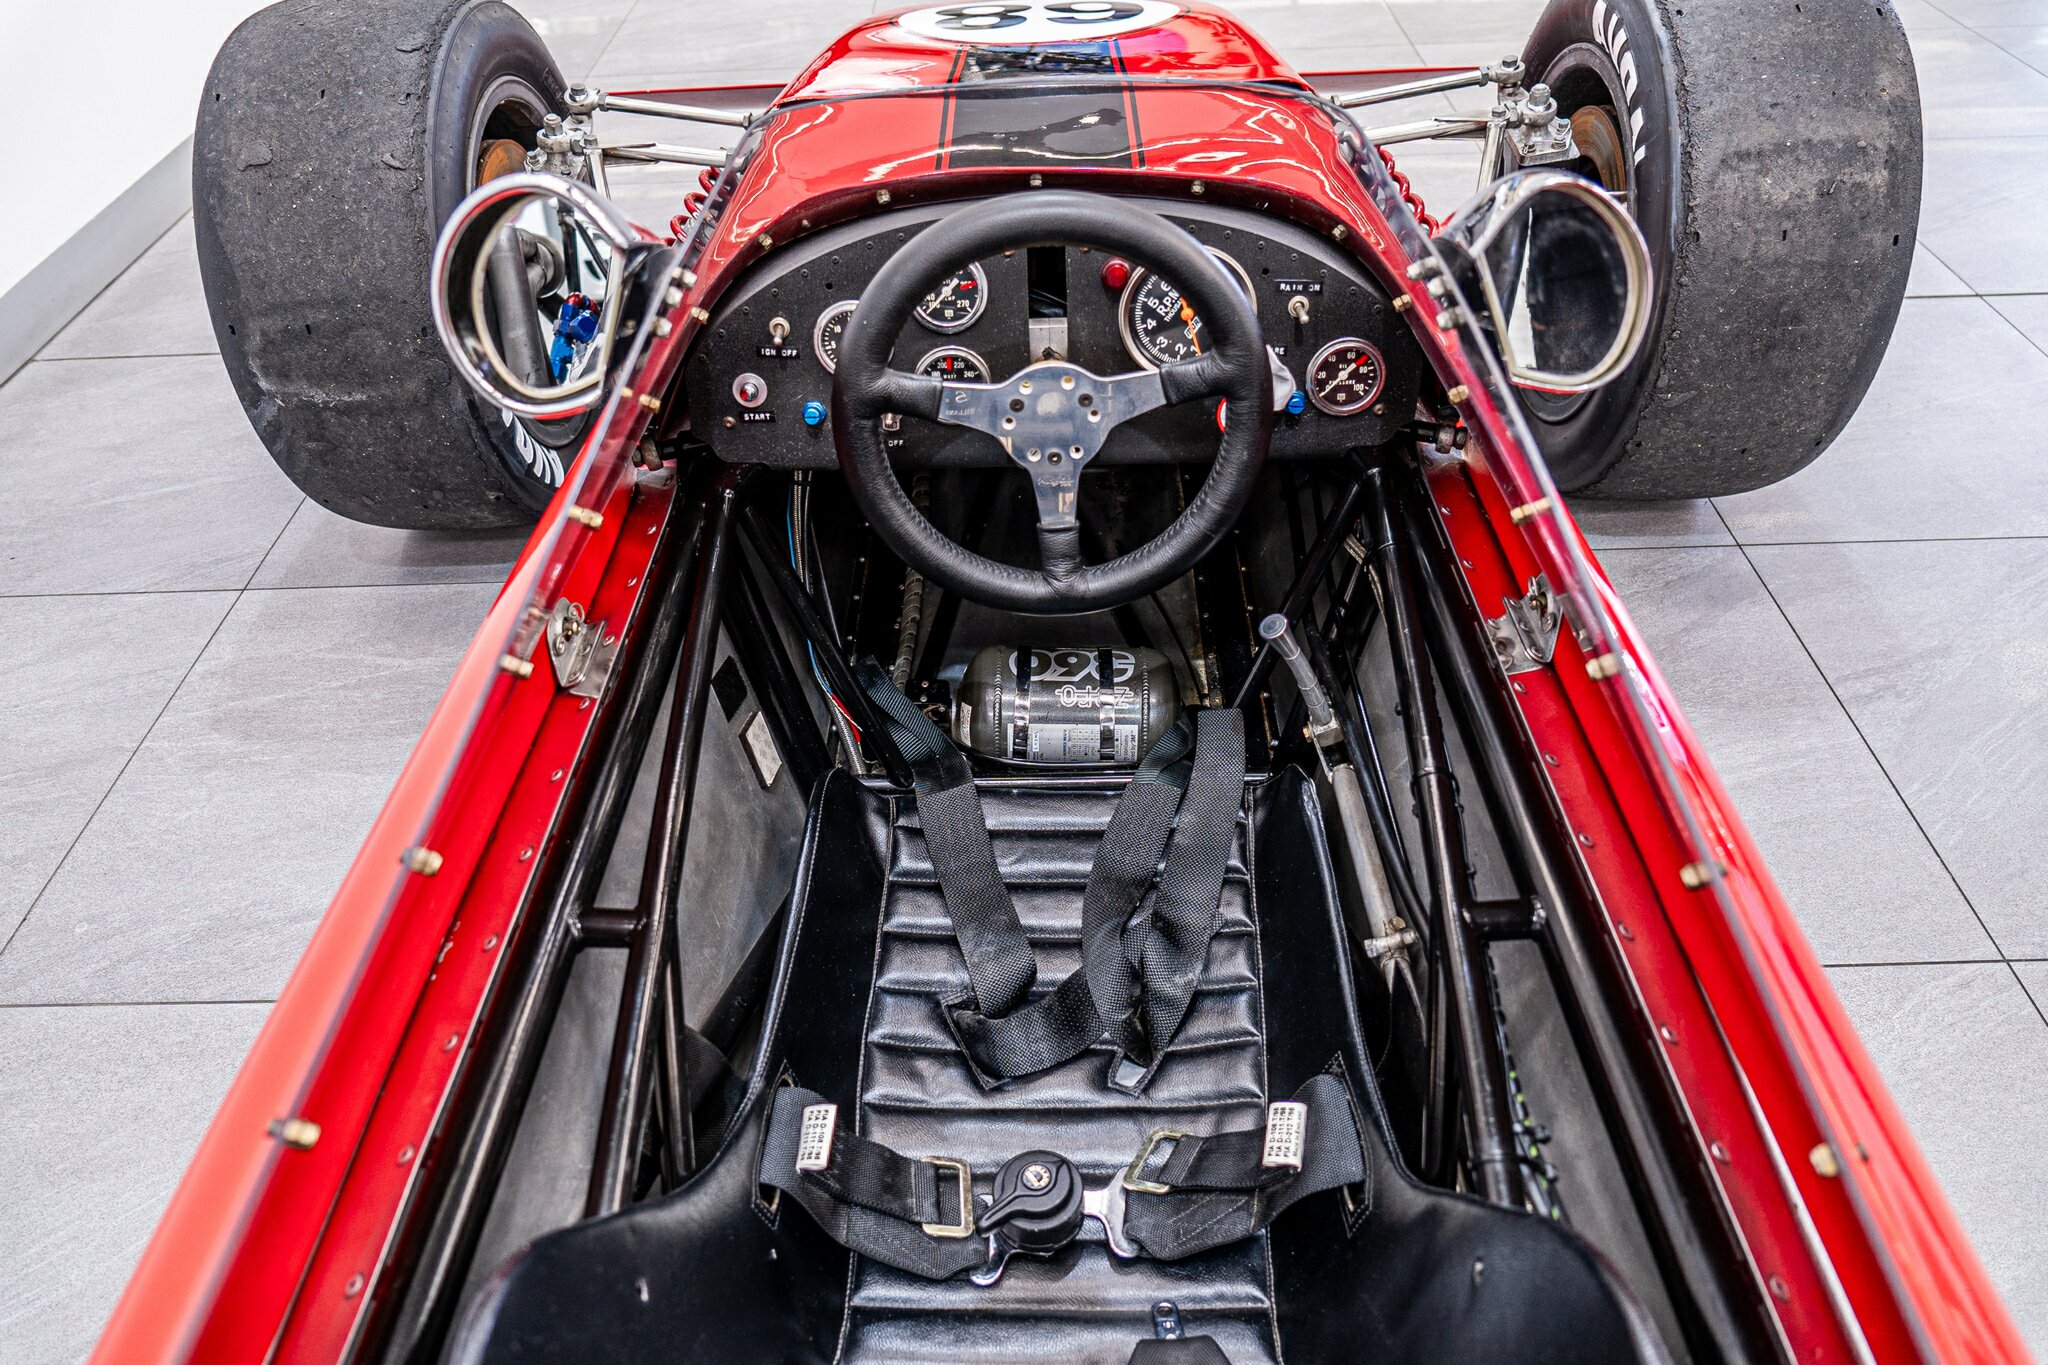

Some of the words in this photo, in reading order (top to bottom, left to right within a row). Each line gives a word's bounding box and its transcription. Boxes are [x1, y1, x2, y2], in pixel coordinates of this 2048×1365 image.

[1280, 283, 1303, 291] RAIN
[956, 300, 970, 308] 270
[1147, 297, 1159, 309] 5
[1163, 300, 1182, 323] THOUSA
[1147, 319, 1157, 330] 4
[833, 325, 842, 333] 10
[830, 341, 837, 349] 5
[1157, 336, 1168, 348] 3
[761, 348, 776, 356] IGN
[781, 349, 798, 357] OFF
[1175, 343, 1187, 355] 2
[1317, 371, 1326, 379] 20
[743, 413, 771, 421] START
[888, 439, 904, 447] OFF
